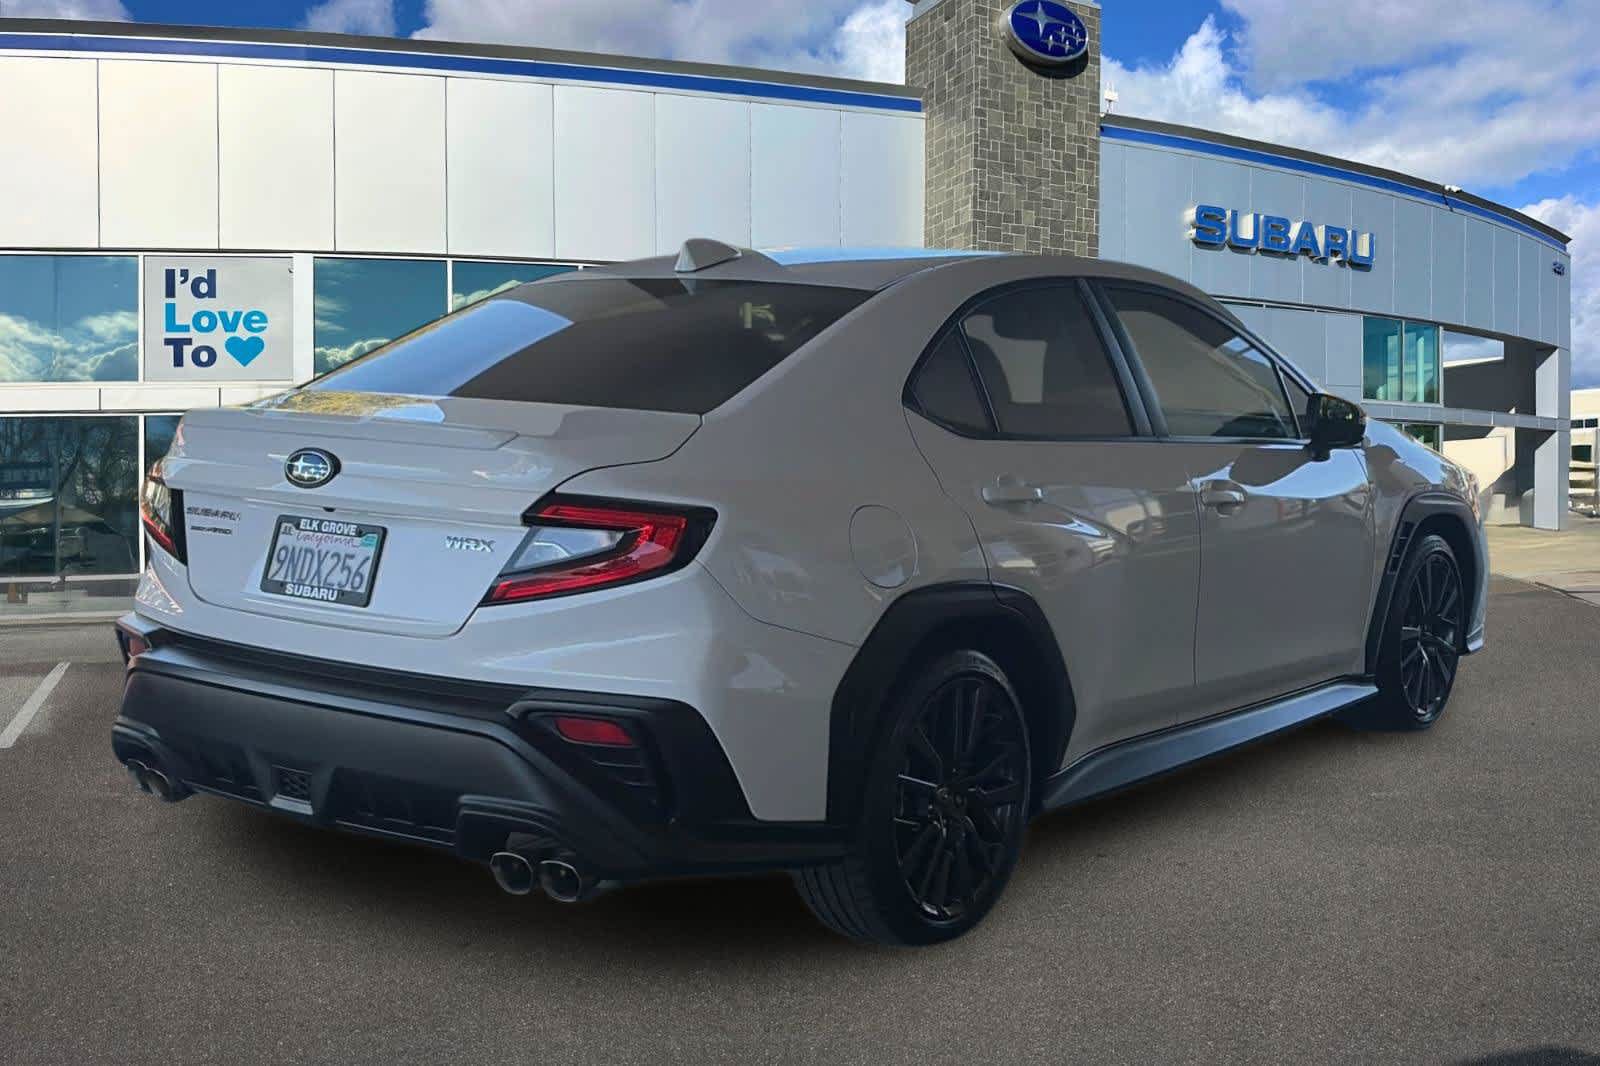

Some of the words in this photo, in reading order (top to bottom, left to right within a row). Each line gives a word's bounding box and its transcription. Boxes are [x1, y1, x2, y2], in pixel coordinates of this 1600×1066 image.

[1191, 204, 1376, 268] SUBARU
[165, 268, 217, 299] I’d
[165, 302, 268, 333] Love
[164, 337, 217, 368] To
[186, 506, 241, 521] SUBARU
[300, 518, 320, 532] ELK
[321, 520, 358, 536] GROVE
[446, 535, 496, 552] WRX
[268, 545, 371, 590] 9NDX256
[285, 583, 338, 601] SUBARU
